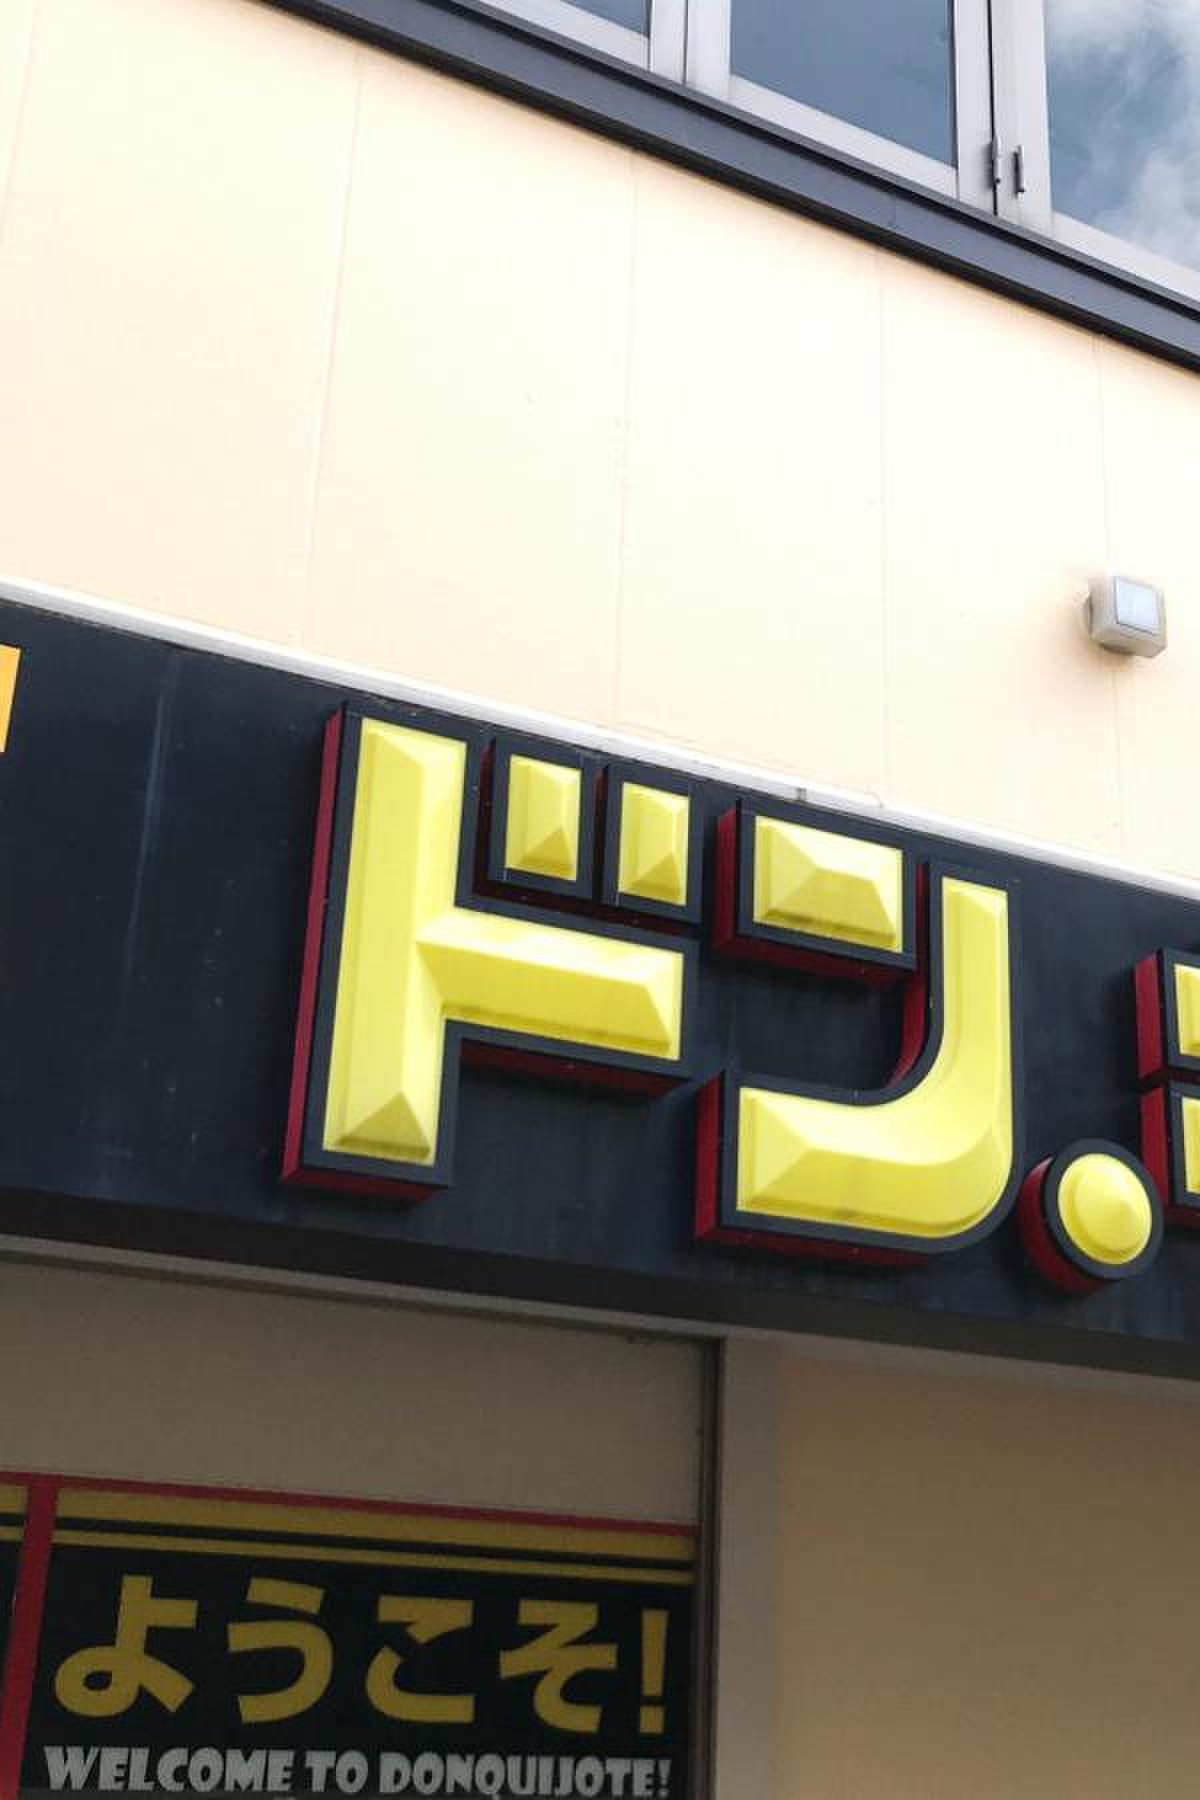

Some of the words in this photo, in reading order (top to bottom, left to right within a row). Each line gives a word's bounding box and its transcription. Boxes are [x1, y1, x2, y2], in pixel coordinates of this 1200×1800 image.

[53, 1573, 670, 1735] ようこそ!
[43, 1745, 295, 1793] WELCOME
[304, 1750, 368, 1794] TO
[379, 1751, 672, 1799] DONQUIJOTE!
